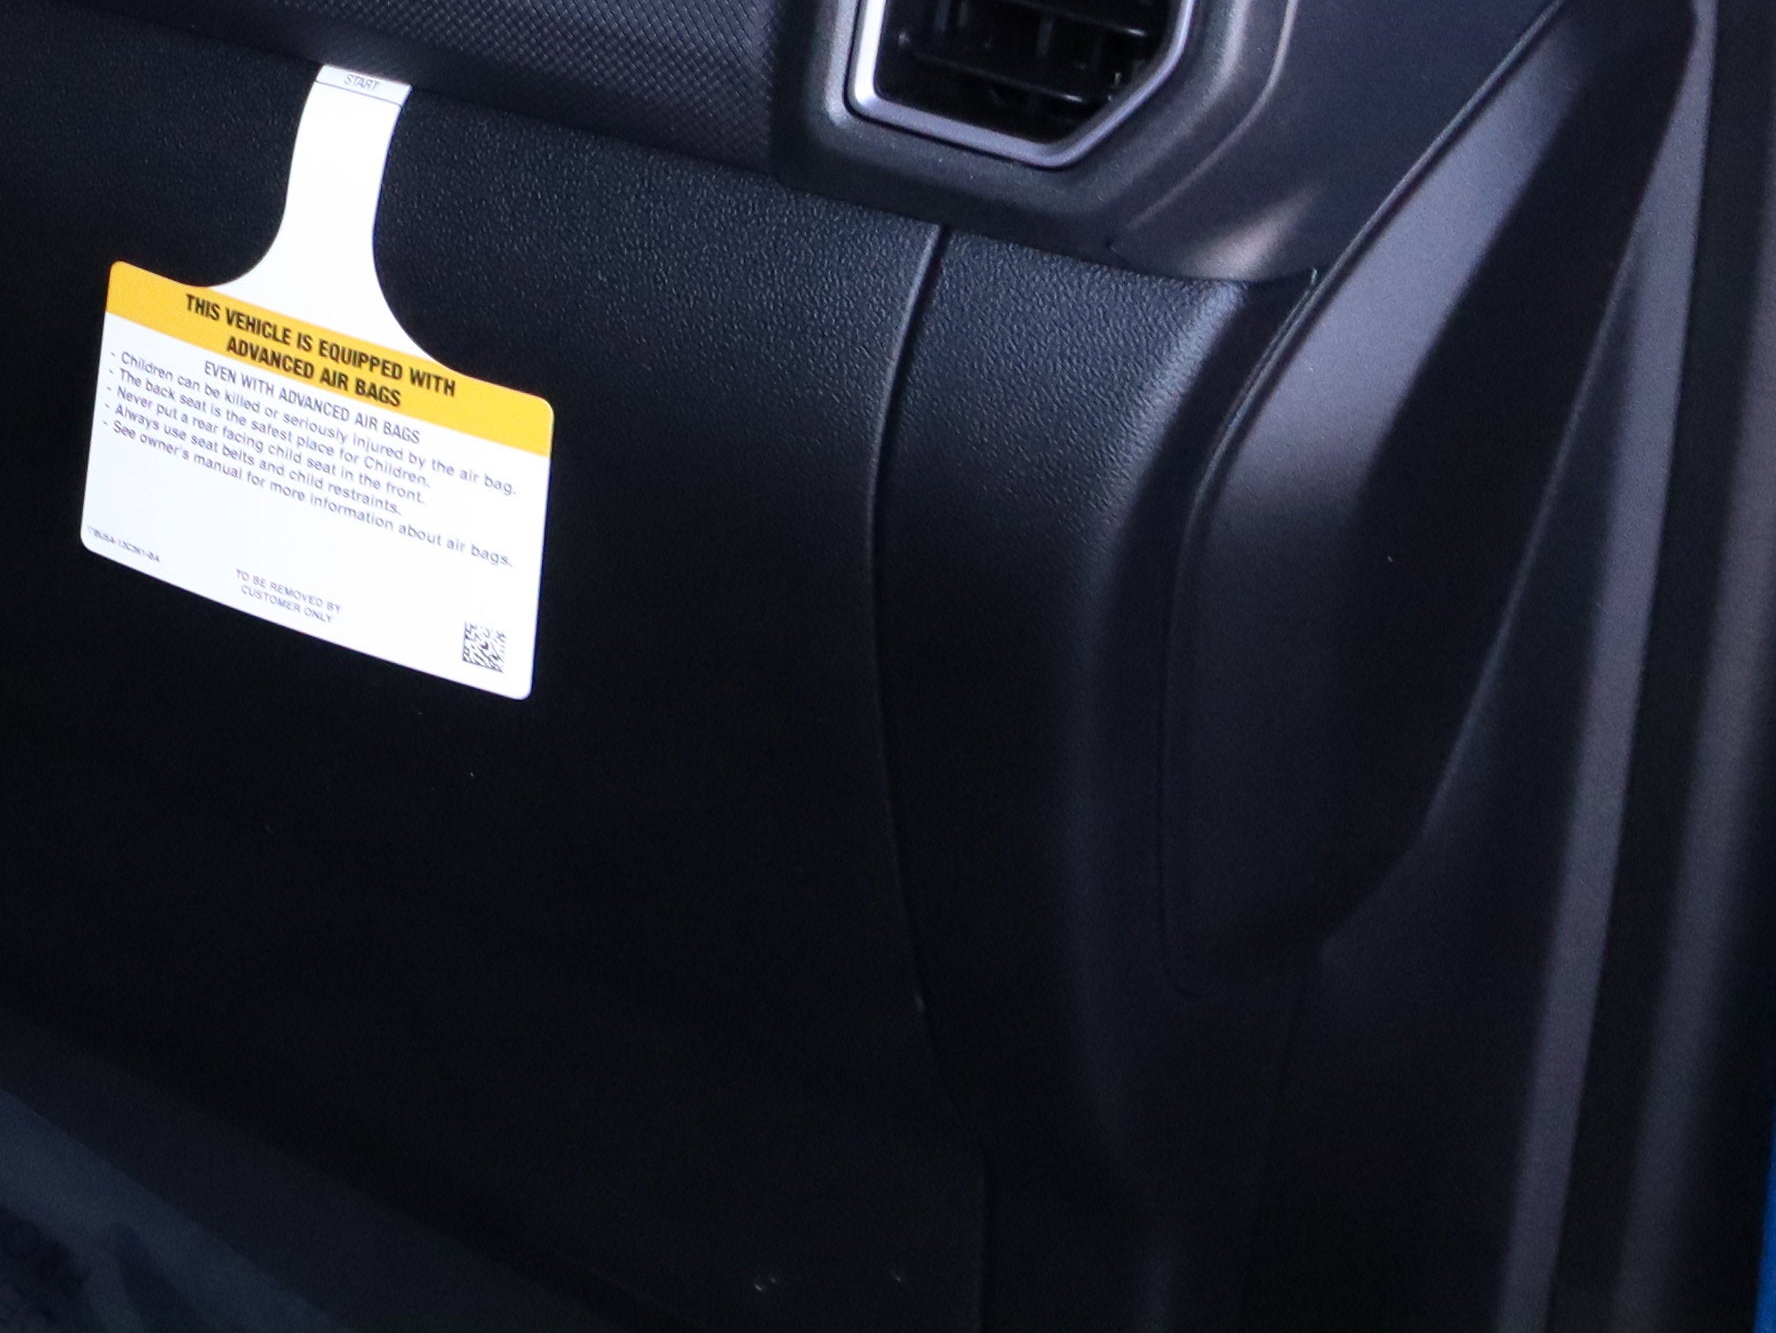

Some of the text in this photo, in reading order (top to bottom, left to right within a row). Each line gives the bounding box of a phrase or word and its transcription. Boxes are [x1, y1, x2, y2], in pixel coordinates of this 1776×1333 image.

[185, 293, 457, 397] THIS VEHICLE IS EQUIPPED WITH
[226, 336, 402, 407] ADVANCED AIR BAGS
[116, 385, 426, 505] Never put a rear facing child seat in the front.
[120, 350, 518, 496] Children can be killed or seriously injured by the air bag.
[120, 367, 432, 489] The back seat is the safest place for Children.
[204, 360, 422, 445] EVEN WITH ADVANCED AIR BAGS
[113, 419, 514, 567] See owner's manual for more information about air bags.
[115, 403, 403, 516] Always use seat belts and child restraints.
[235, 568, 342, 613] TO BE REMOVED BY
[240, 583, 333, 623] CUSTOMER ONLY
